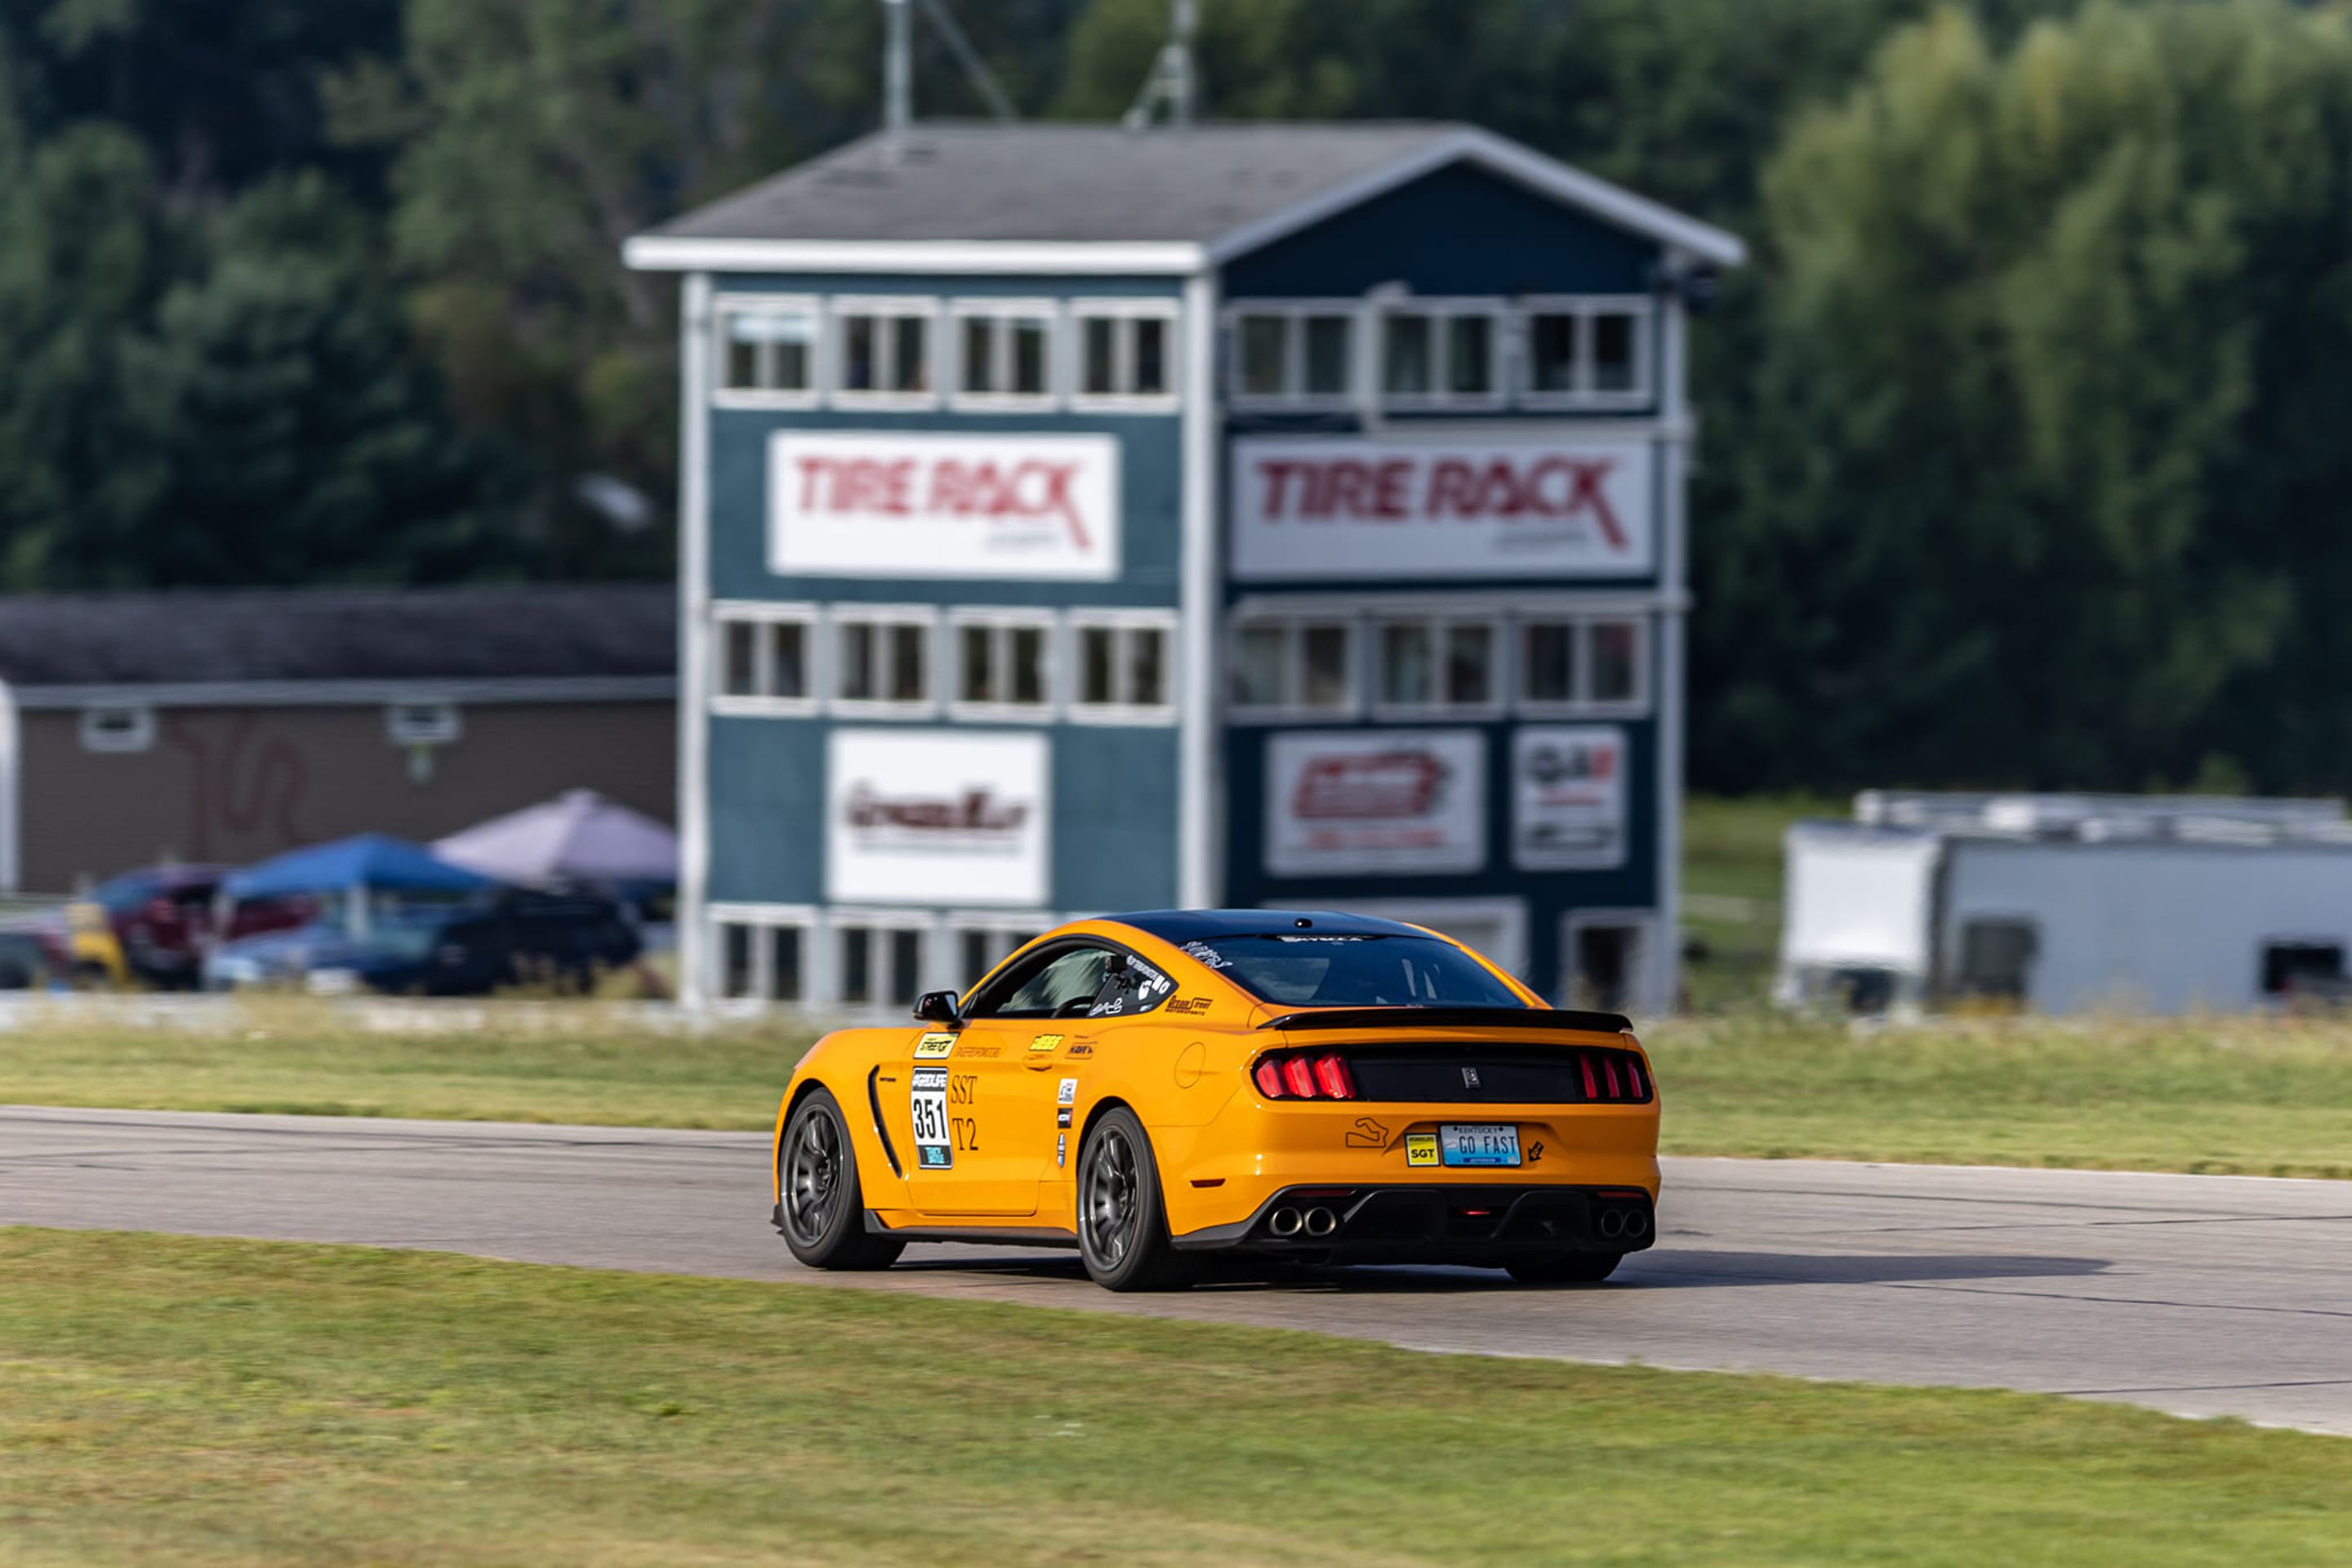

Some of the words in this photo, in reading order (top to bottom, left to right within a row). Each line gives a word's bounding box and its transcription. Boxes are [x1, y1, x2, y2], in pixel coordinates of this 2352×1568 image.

[797, 457, 915, 518] TIRE
[929, 457, 1091, 553] RACK
[1258, 456, 1414, 522] TIRE
[1423, 454, 1629, 550] RACK
[951, 1075, 978, 1104] SST
[913, 1098, 947, 1139] 351
[1459, 1126, 1498, 1134] KENTUCKY
[1411, 1149, 1435, 1158] SGT
[1459, 1135, 1476, 1154] GO
[1484, 1136, 1515, 1154] FAST
